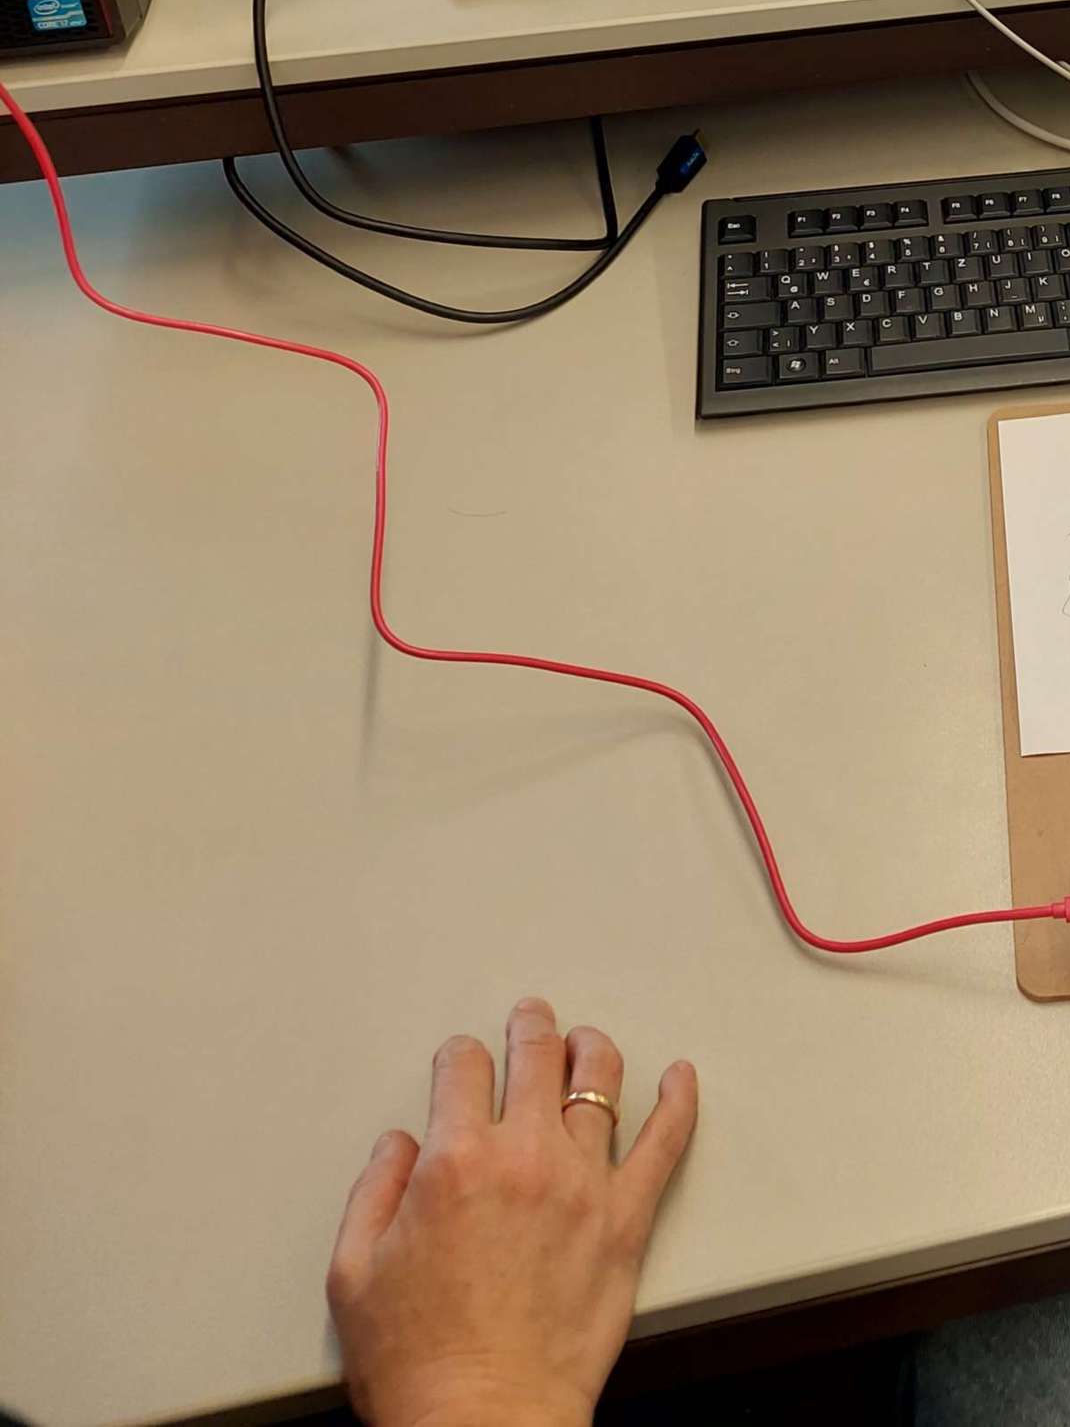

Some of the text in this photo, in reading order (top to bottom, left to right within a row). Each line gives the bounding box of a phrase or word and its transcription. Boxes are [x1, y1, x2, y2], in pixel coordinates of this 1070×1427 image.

[1061, 249, 1070, 257] O
[958, 258, 966, 267] Z
[992, 255, 1000, 264] U
[888, 266, 896, 274] R
[922, 262, 931, 270] T
[816, 272, 829, 281] W
[852, 269, 860, 277] E
[780, 275, 791, 285] Q
[1004, 280, 1011, 289] J
[1039, 278, 1049, 286] K
[934, 287, 944, 296] G
[968, 284, 978, 292] H
[862, 294, 871, 303] D
[898, 291, 906, 299] F
[790, 301, 800, 310] A
[826, 298, 835, 306] S
[990, 309, 999, 318] N
[1025, 305, 1036, 314] M
[918, 316, 928, 324] V
[954, 312, 962, 320] B
[846, 322, 856, 331] X
[882, 319, 892, 328] C
[809, 326, 819, 334] Y
